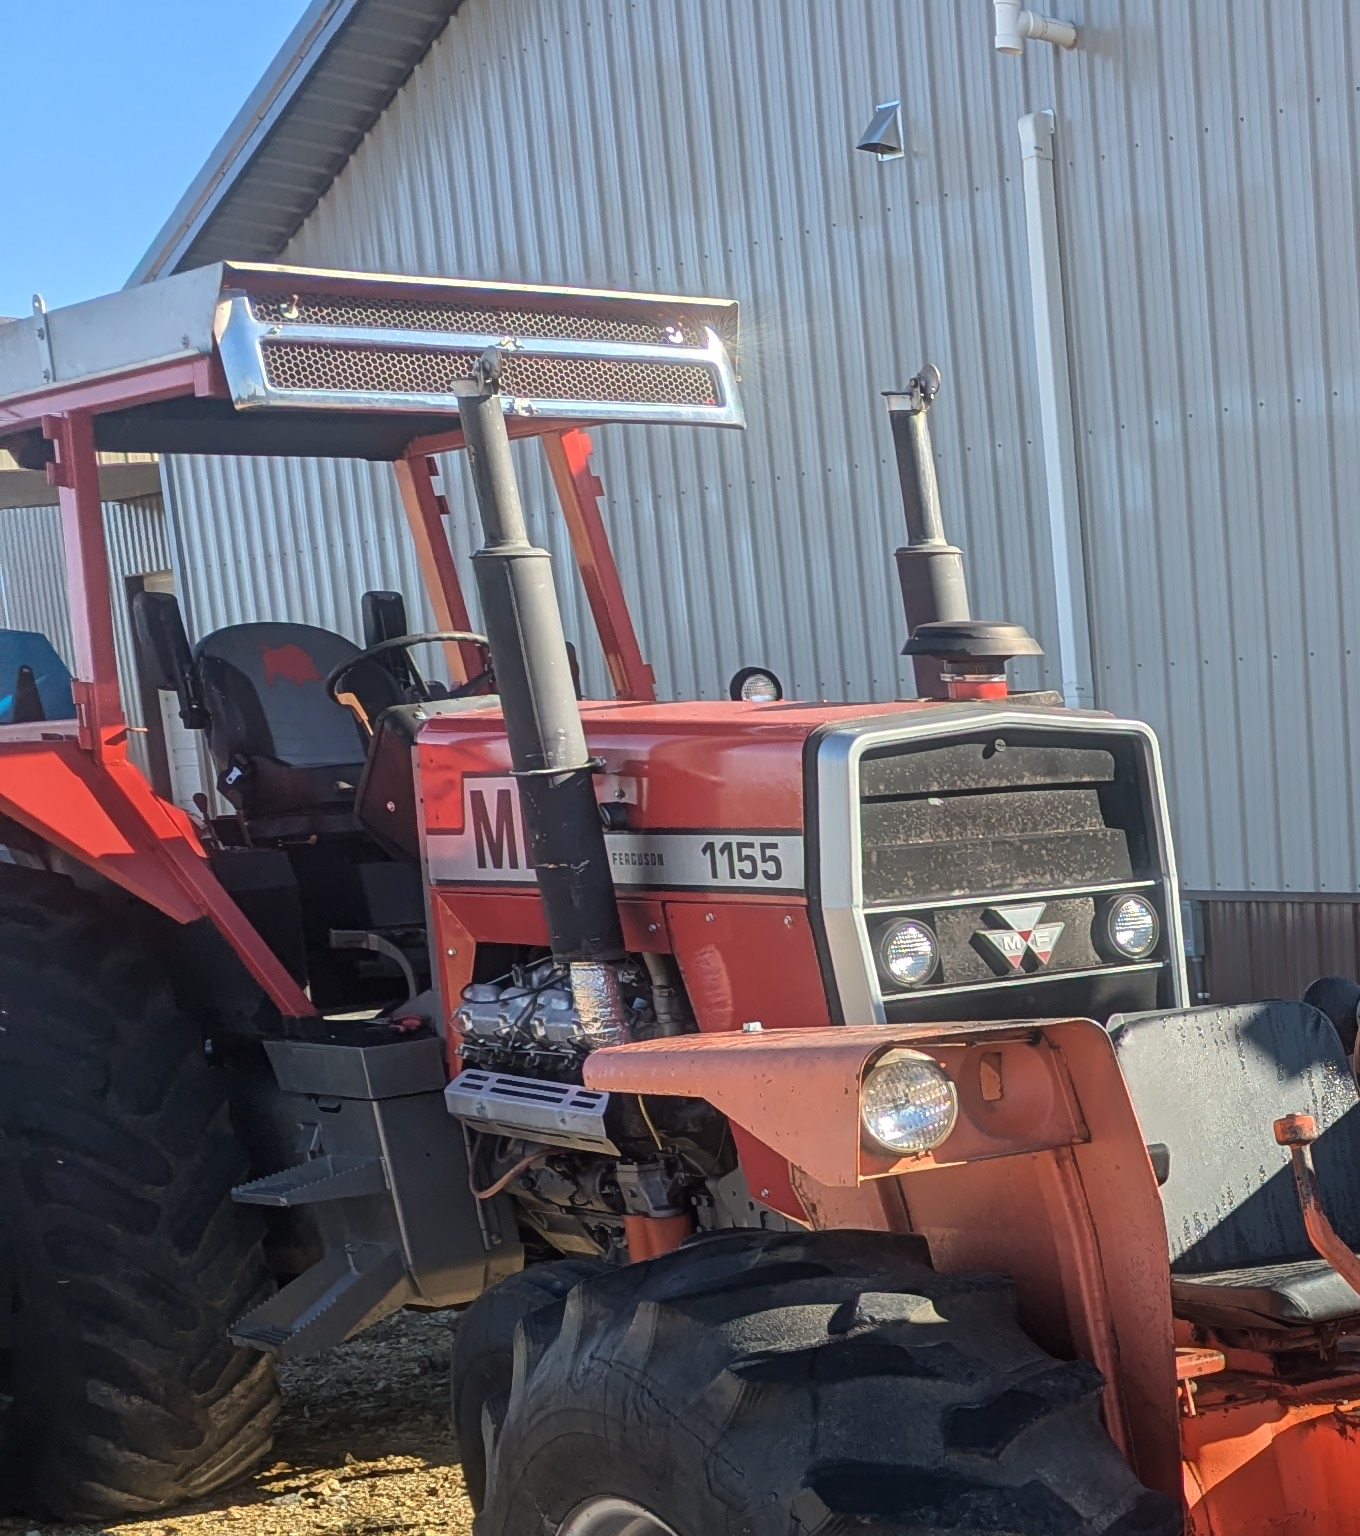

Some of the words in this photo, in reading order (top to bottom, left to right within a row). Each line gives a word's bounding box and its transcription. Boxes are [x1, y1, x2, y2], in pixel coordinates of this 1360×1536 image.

[469, 788, 537, 870] M
[612, 851, 665, 867] FERGUSON
[700, 841, 783, 881] 1155
